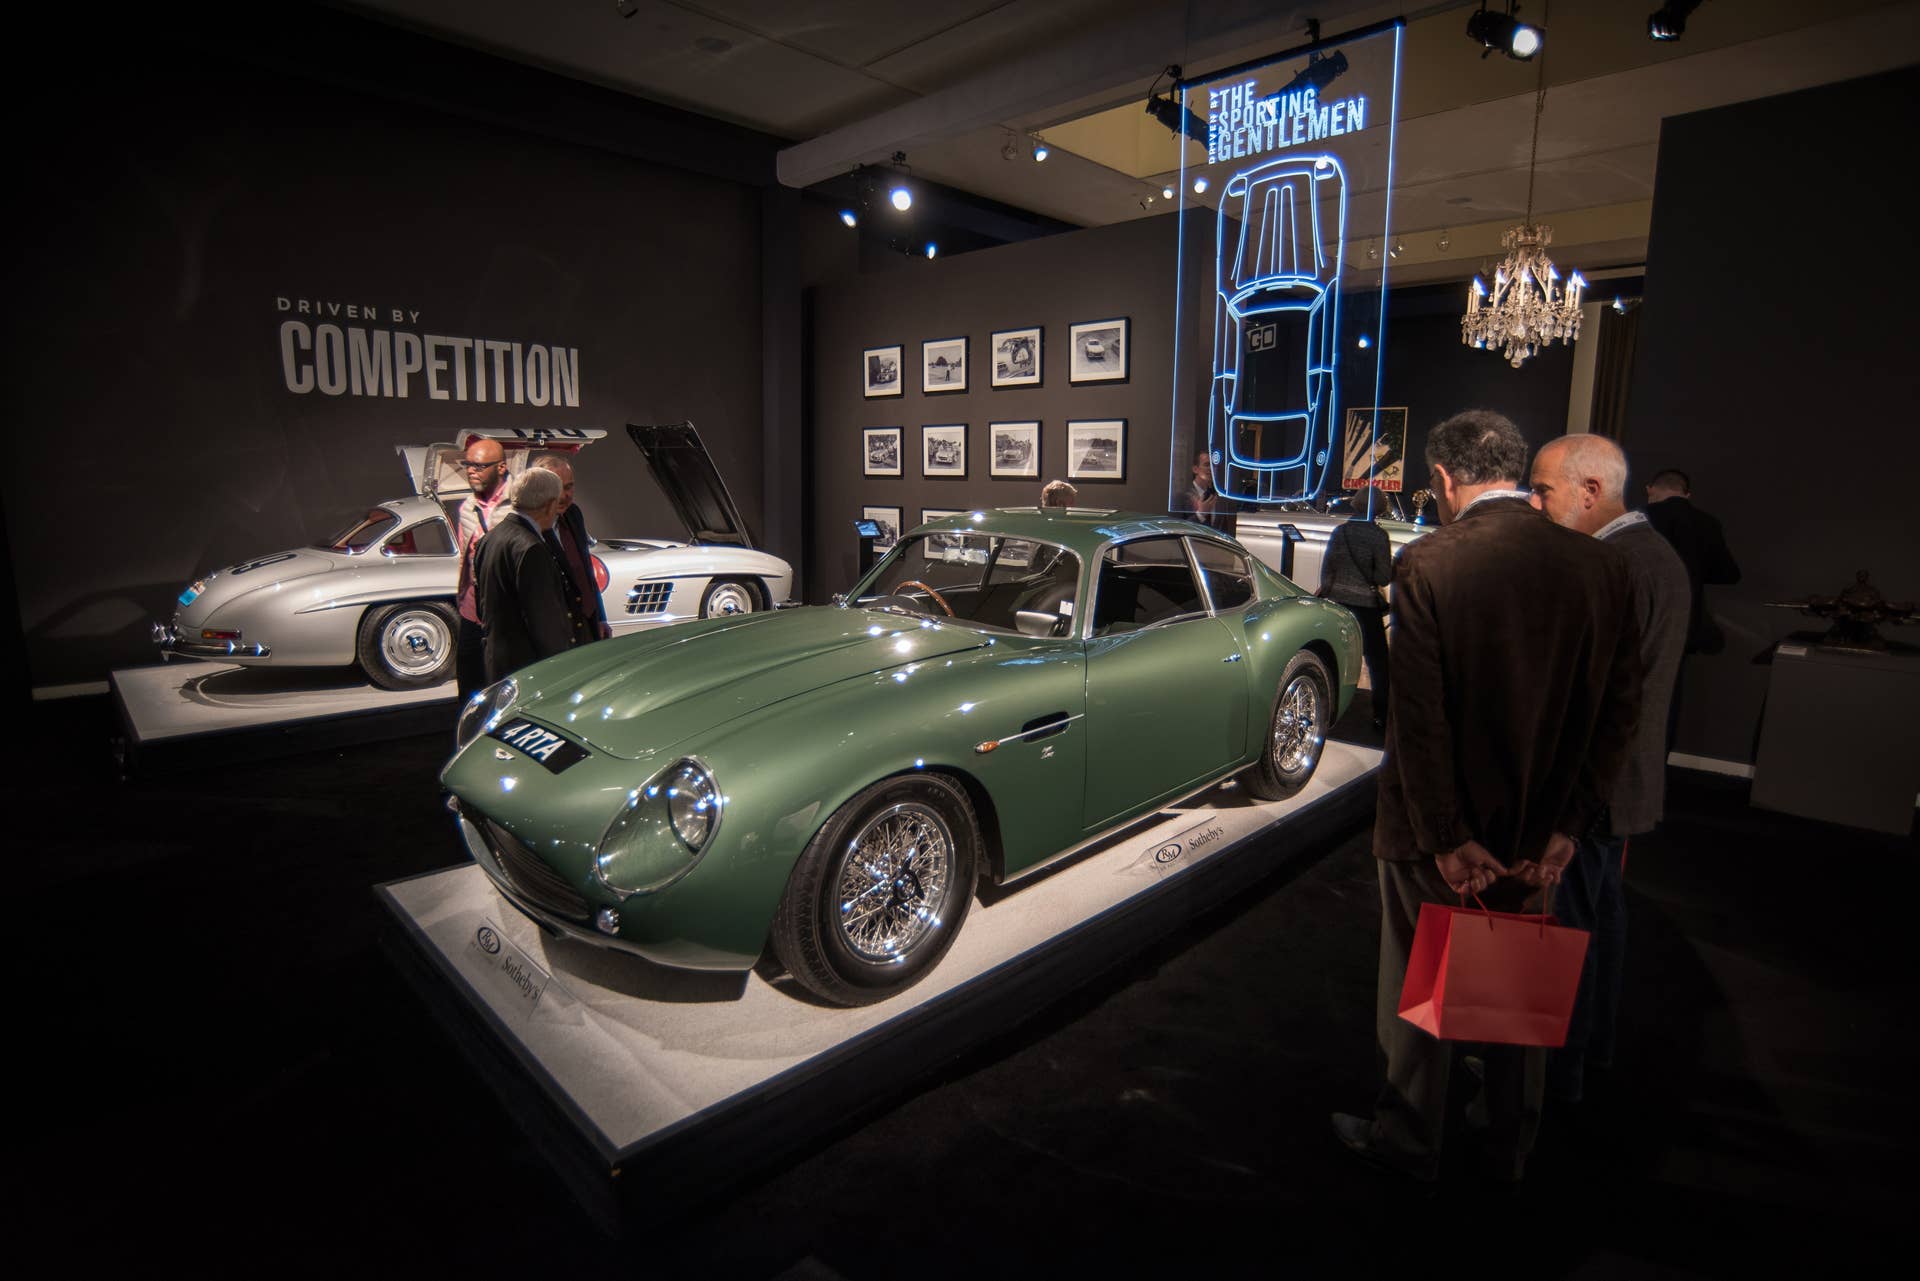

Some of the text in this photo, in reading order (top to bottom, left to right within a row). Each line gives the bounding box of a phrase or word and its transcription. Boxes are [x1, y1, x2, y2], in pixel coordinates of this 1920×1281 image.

[1218, 88, 1318, 134] SPORTING
[1219, 82, 1256, 113] THE
[1217, 97, 1365, 161] GENTLEMEN
[277, 297, 421, 324] DRIVEN BY
[280, 321, 580, 408] COMPETITION
[1187, 825, 1225, 850] Sotheby's
[502, 956, 540, 1000] Sotheby's
